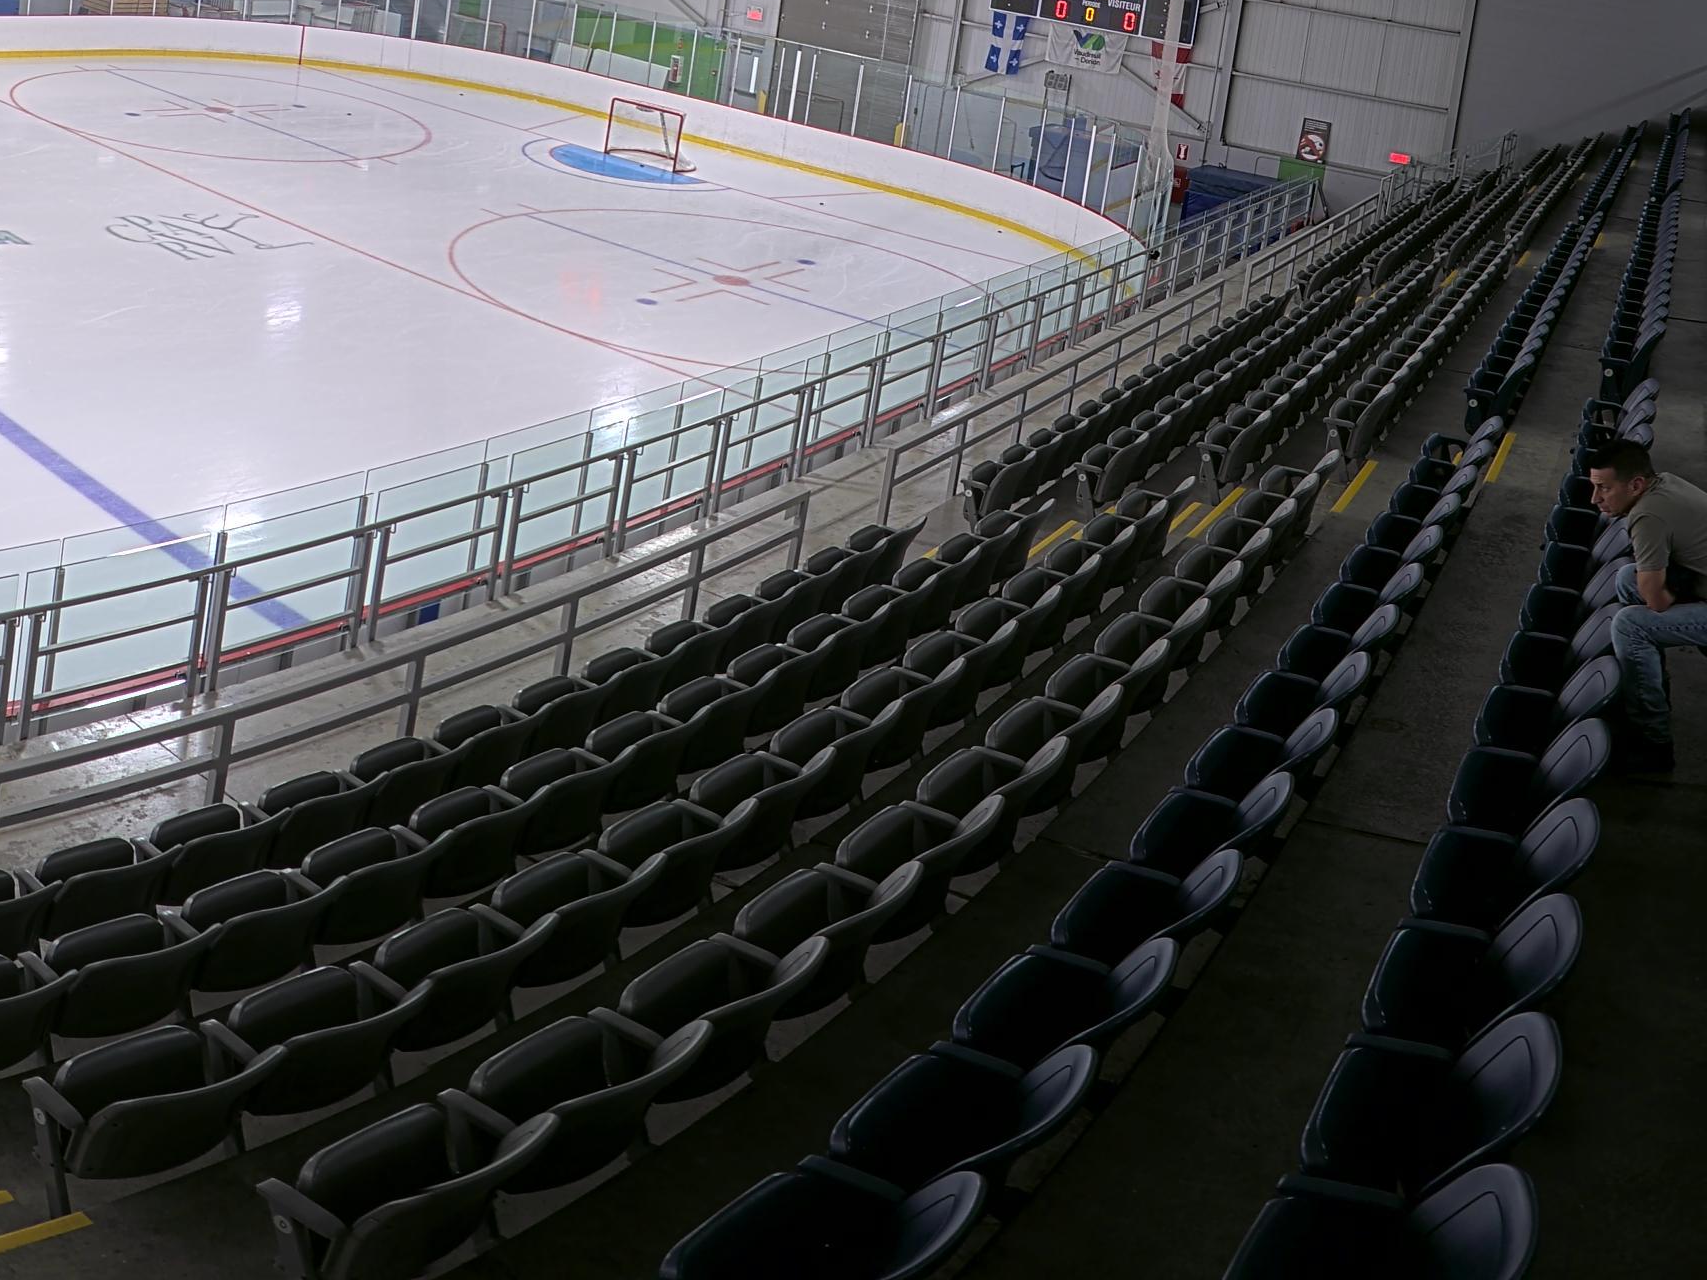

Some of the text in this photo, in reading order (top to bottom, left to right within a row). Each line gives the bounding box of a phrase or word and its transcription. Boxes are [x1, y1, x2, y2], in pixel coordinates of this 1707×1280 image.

[1055, 0, 1068, 19] 0
[1085, 7, 1095, 23] 0
[1123, 12, 1136, 32] 0
[1073, 48, 1101, 59] Vaudreuil
